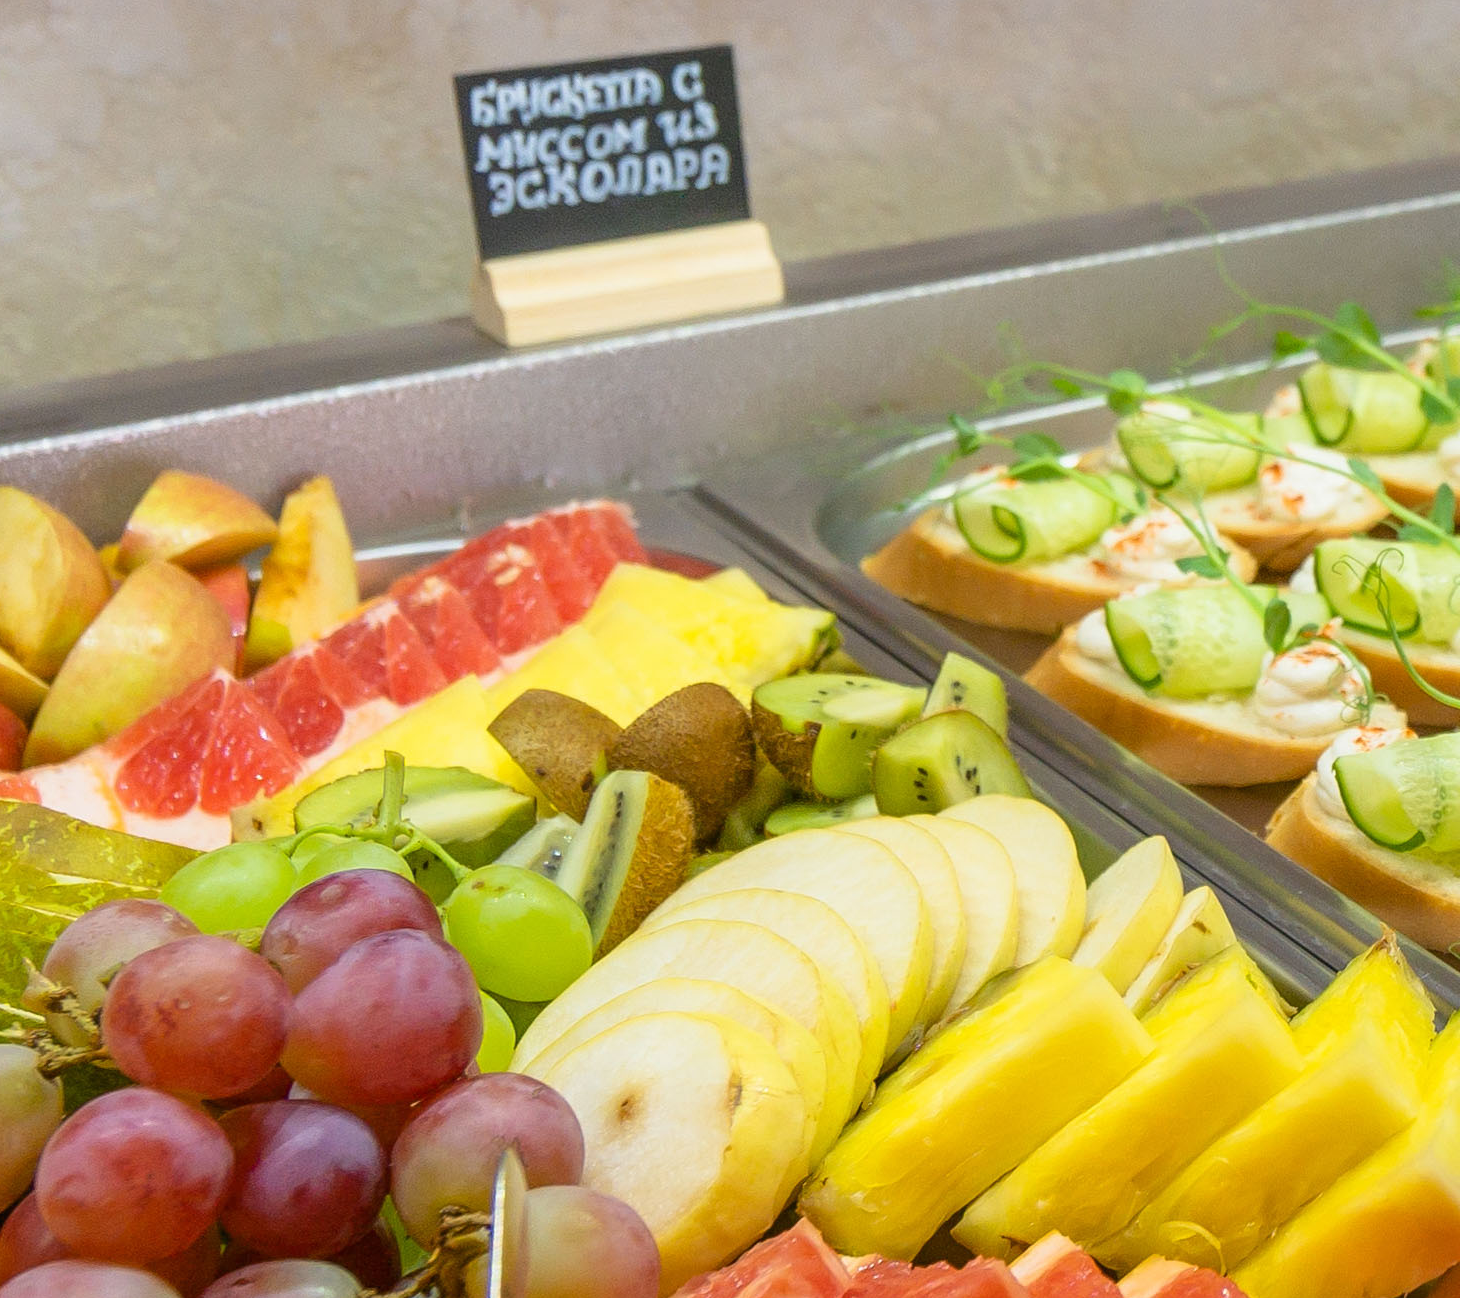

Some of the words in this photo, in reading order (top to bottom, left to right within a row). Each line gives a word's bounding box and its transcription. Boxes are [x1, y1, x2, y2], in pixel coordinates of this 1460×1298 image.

[672, 62, 704, 101] С
[655, 100, 720, 148] ИЗ
[488, 142, 732, 218] ЭСКОЛАРА
